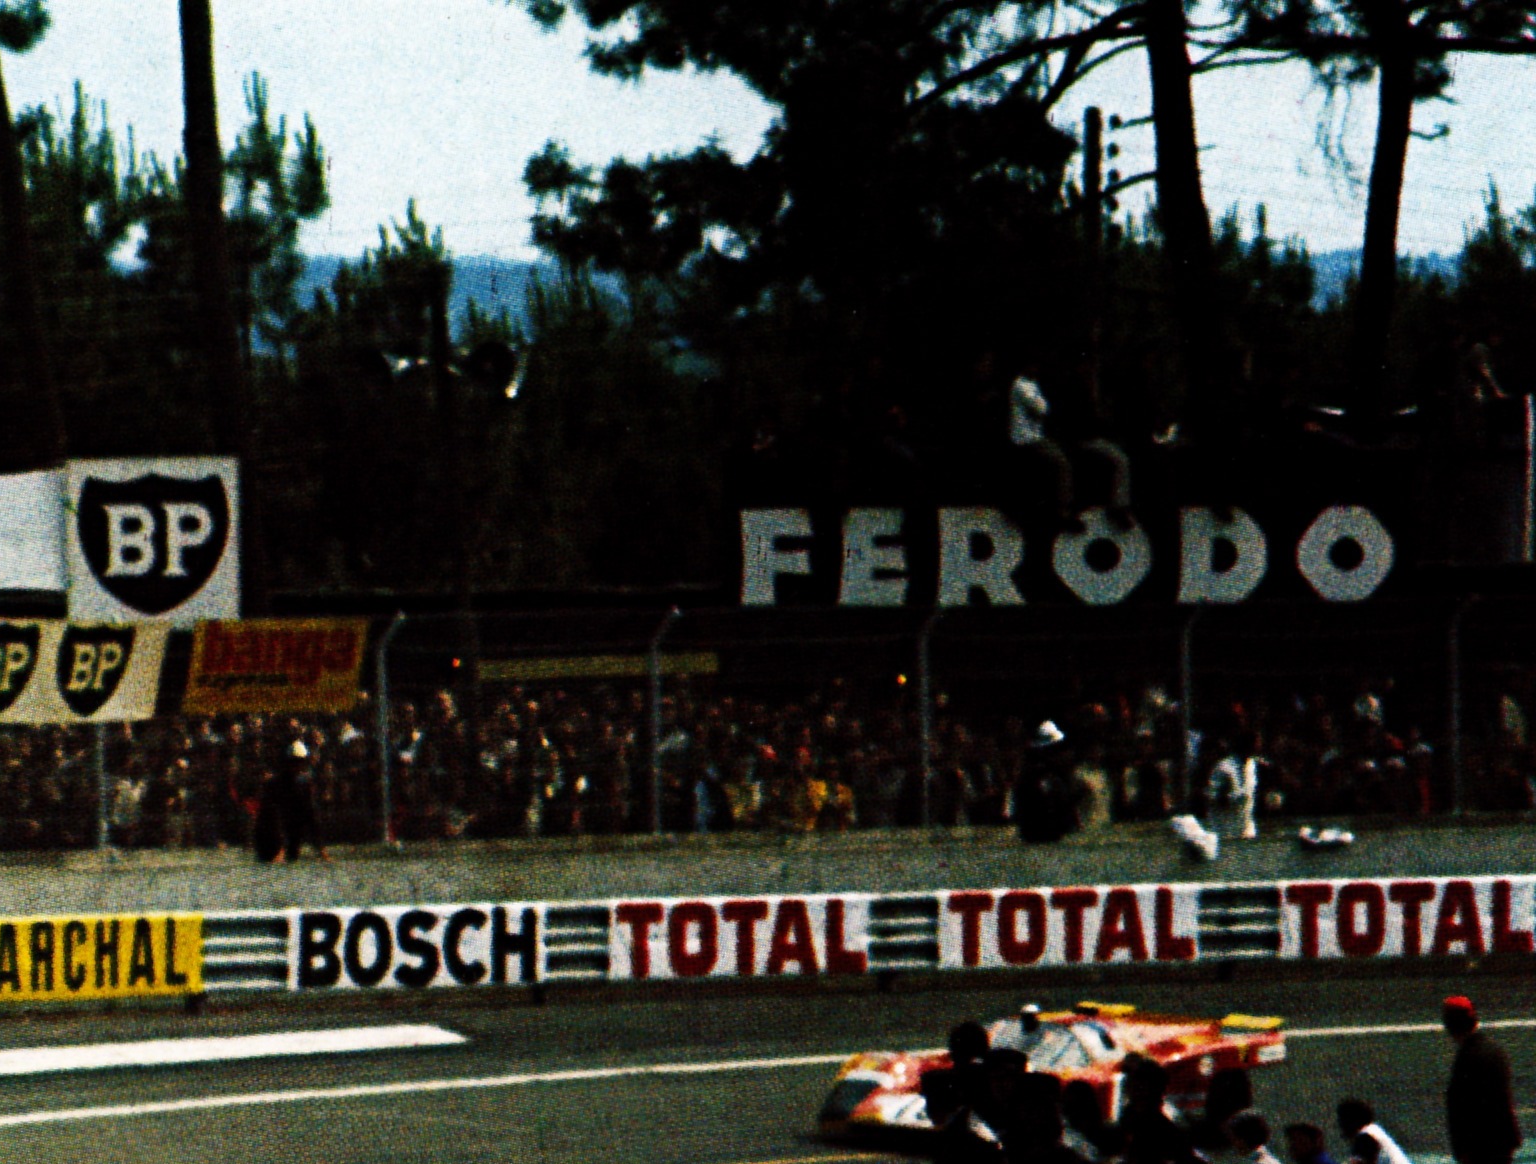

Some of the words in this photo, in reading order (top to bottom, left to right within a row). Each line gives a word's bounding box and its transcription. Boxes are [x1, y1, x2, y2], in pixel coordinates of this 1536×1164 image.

[105, 503, 213, 577] BP
[740, 507, 1395, 604] FERODO
[67, 643, 123, 691] BP
[298, 906, 537, 987] BOSCH
[616, 900, 868, 978] TOTAL
[948, 889, 1196, 965] TOTAL
[1286, 880, 1535, 957] TOTAL
